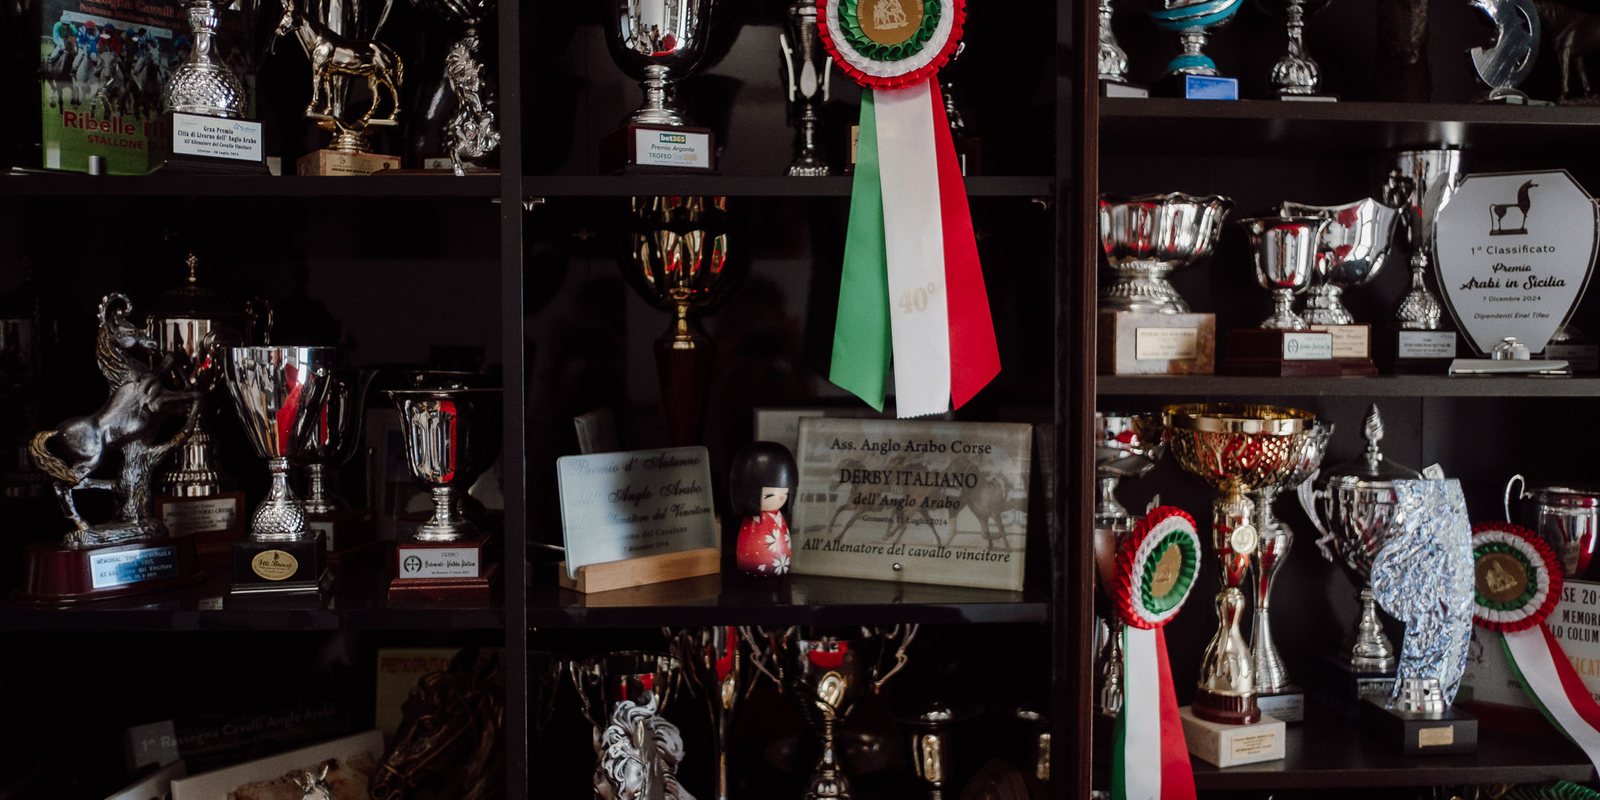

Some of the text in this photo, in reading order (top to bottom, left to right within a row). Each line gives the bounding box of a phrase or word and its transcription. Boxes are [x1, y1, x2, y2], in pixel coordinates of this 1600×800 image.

[64, 111, 135, 135] Ribelle
[216, 127, 234, 135] Premio
[87, 134, 144, 149] STALLONE
[660, 134, 685, 143] bet365
[1486, 245, 1556, 256] Classificato
[1492, 263, 1532, 274] Premio
[1459, 275, 1566, 290] Arabi in Sicilia
[1474, 312, 1512, 320] Dipendenti
[830, 438, 992, 456] Ass. Anglo Arabo Corse
[840, 469, 978, 489] DERBY ITALIANO
[660, 480, 702, 498] Arabo
[854, 492, 961, 510] dell'Anglo Arabo
[802, 538, 1010, 563] All'Allenatore del cavallo vincitore
[1560, 588, 1600, 605] SE 20
